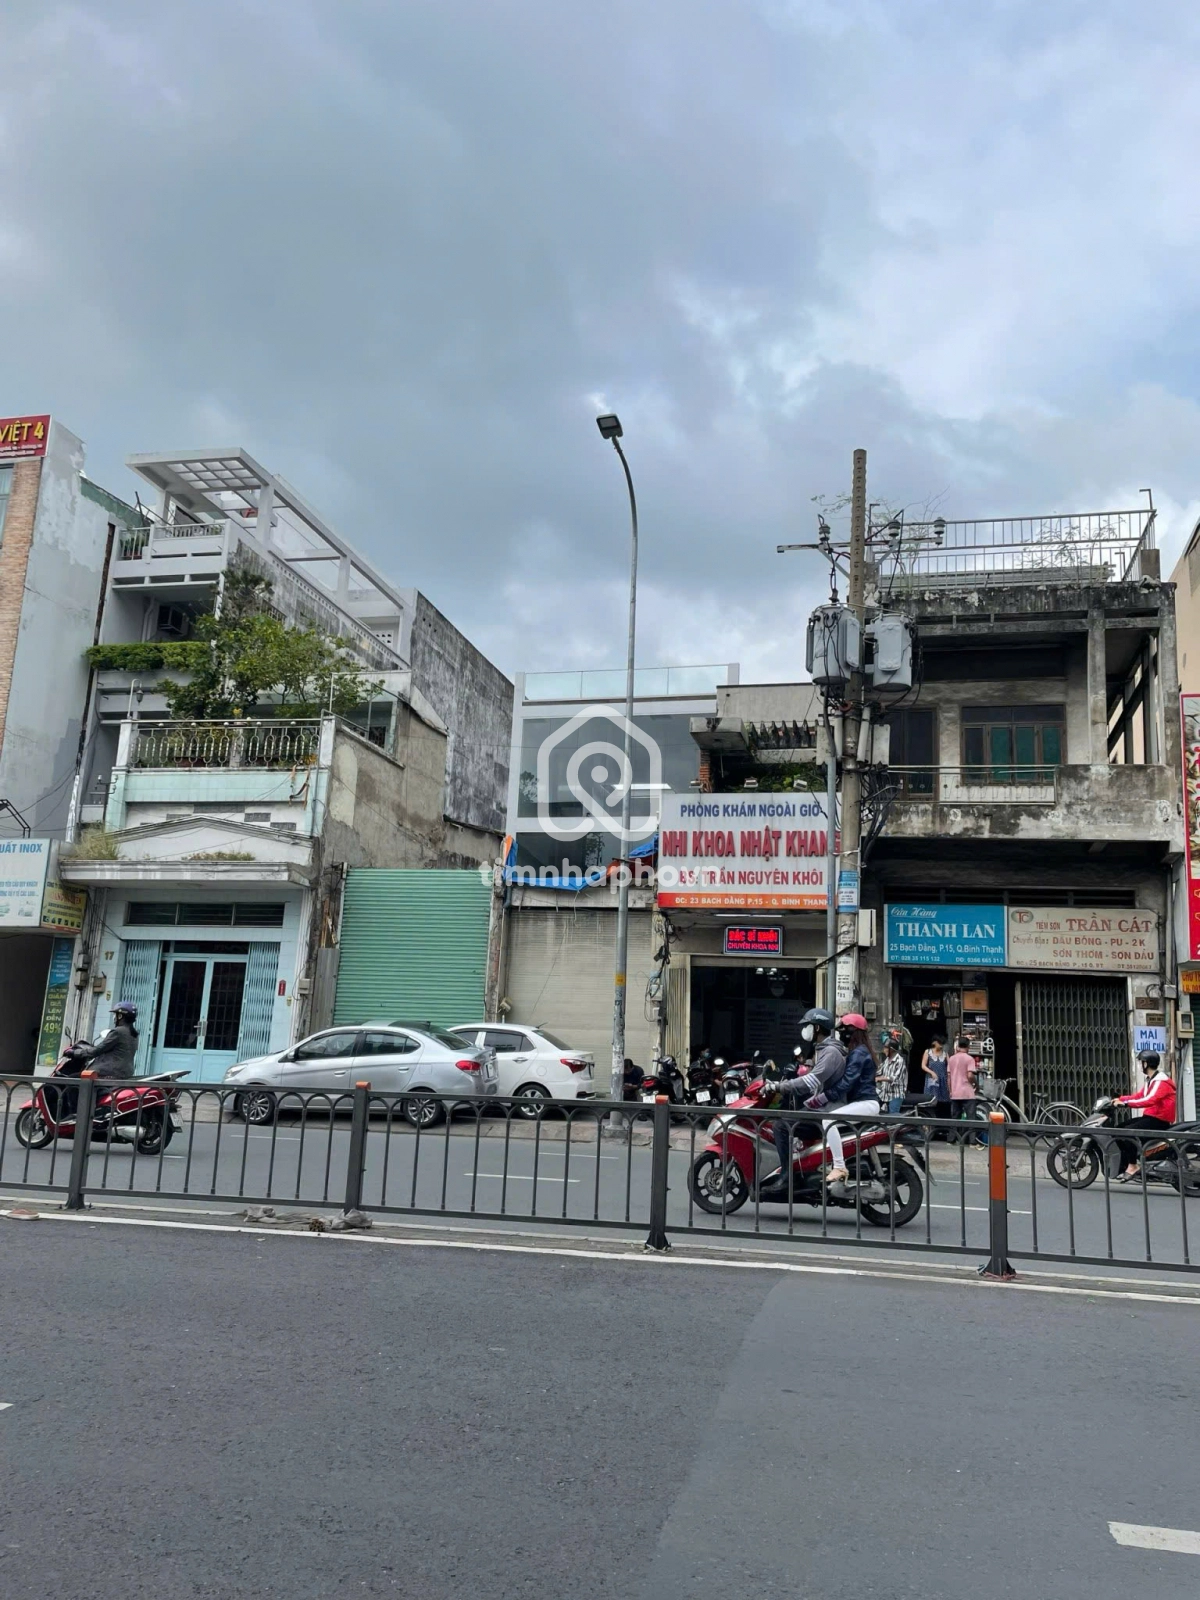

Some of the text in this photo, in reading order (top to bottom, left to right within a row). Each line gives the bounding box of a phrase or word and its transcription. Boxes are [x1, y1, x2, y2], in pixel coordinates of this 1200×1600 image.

[34, 422, 44, 440] 4
[680, 801, 720, 817] PHÒNG
[722, 801, 756, 817] KHÁM
[759, 801, 796, 817] NGOÀI
[20, 843, 43, 853] INOX
[662, 830, 688, 857] NHI
[692, 830, 736, 857] KHOA
[740, 824, 782, 862] NHẬT
[738, 868, 789, 885] NGUYÊN
[792, 868, 823, 885] KHÔI
[895, 922, 996, 938] THANH LAN
[1066, 912, 1112, 931] TRẦN
[1118, 916, 1152, 932] CÁT
[900, 943, 917, 953] Bạch
[982, 945, 1004, 955] Thạnh
[1110, 938, 1123, 946] PU
[105, 951, 114, 961] 17
[44, 1023, 61, 1033] 49%
